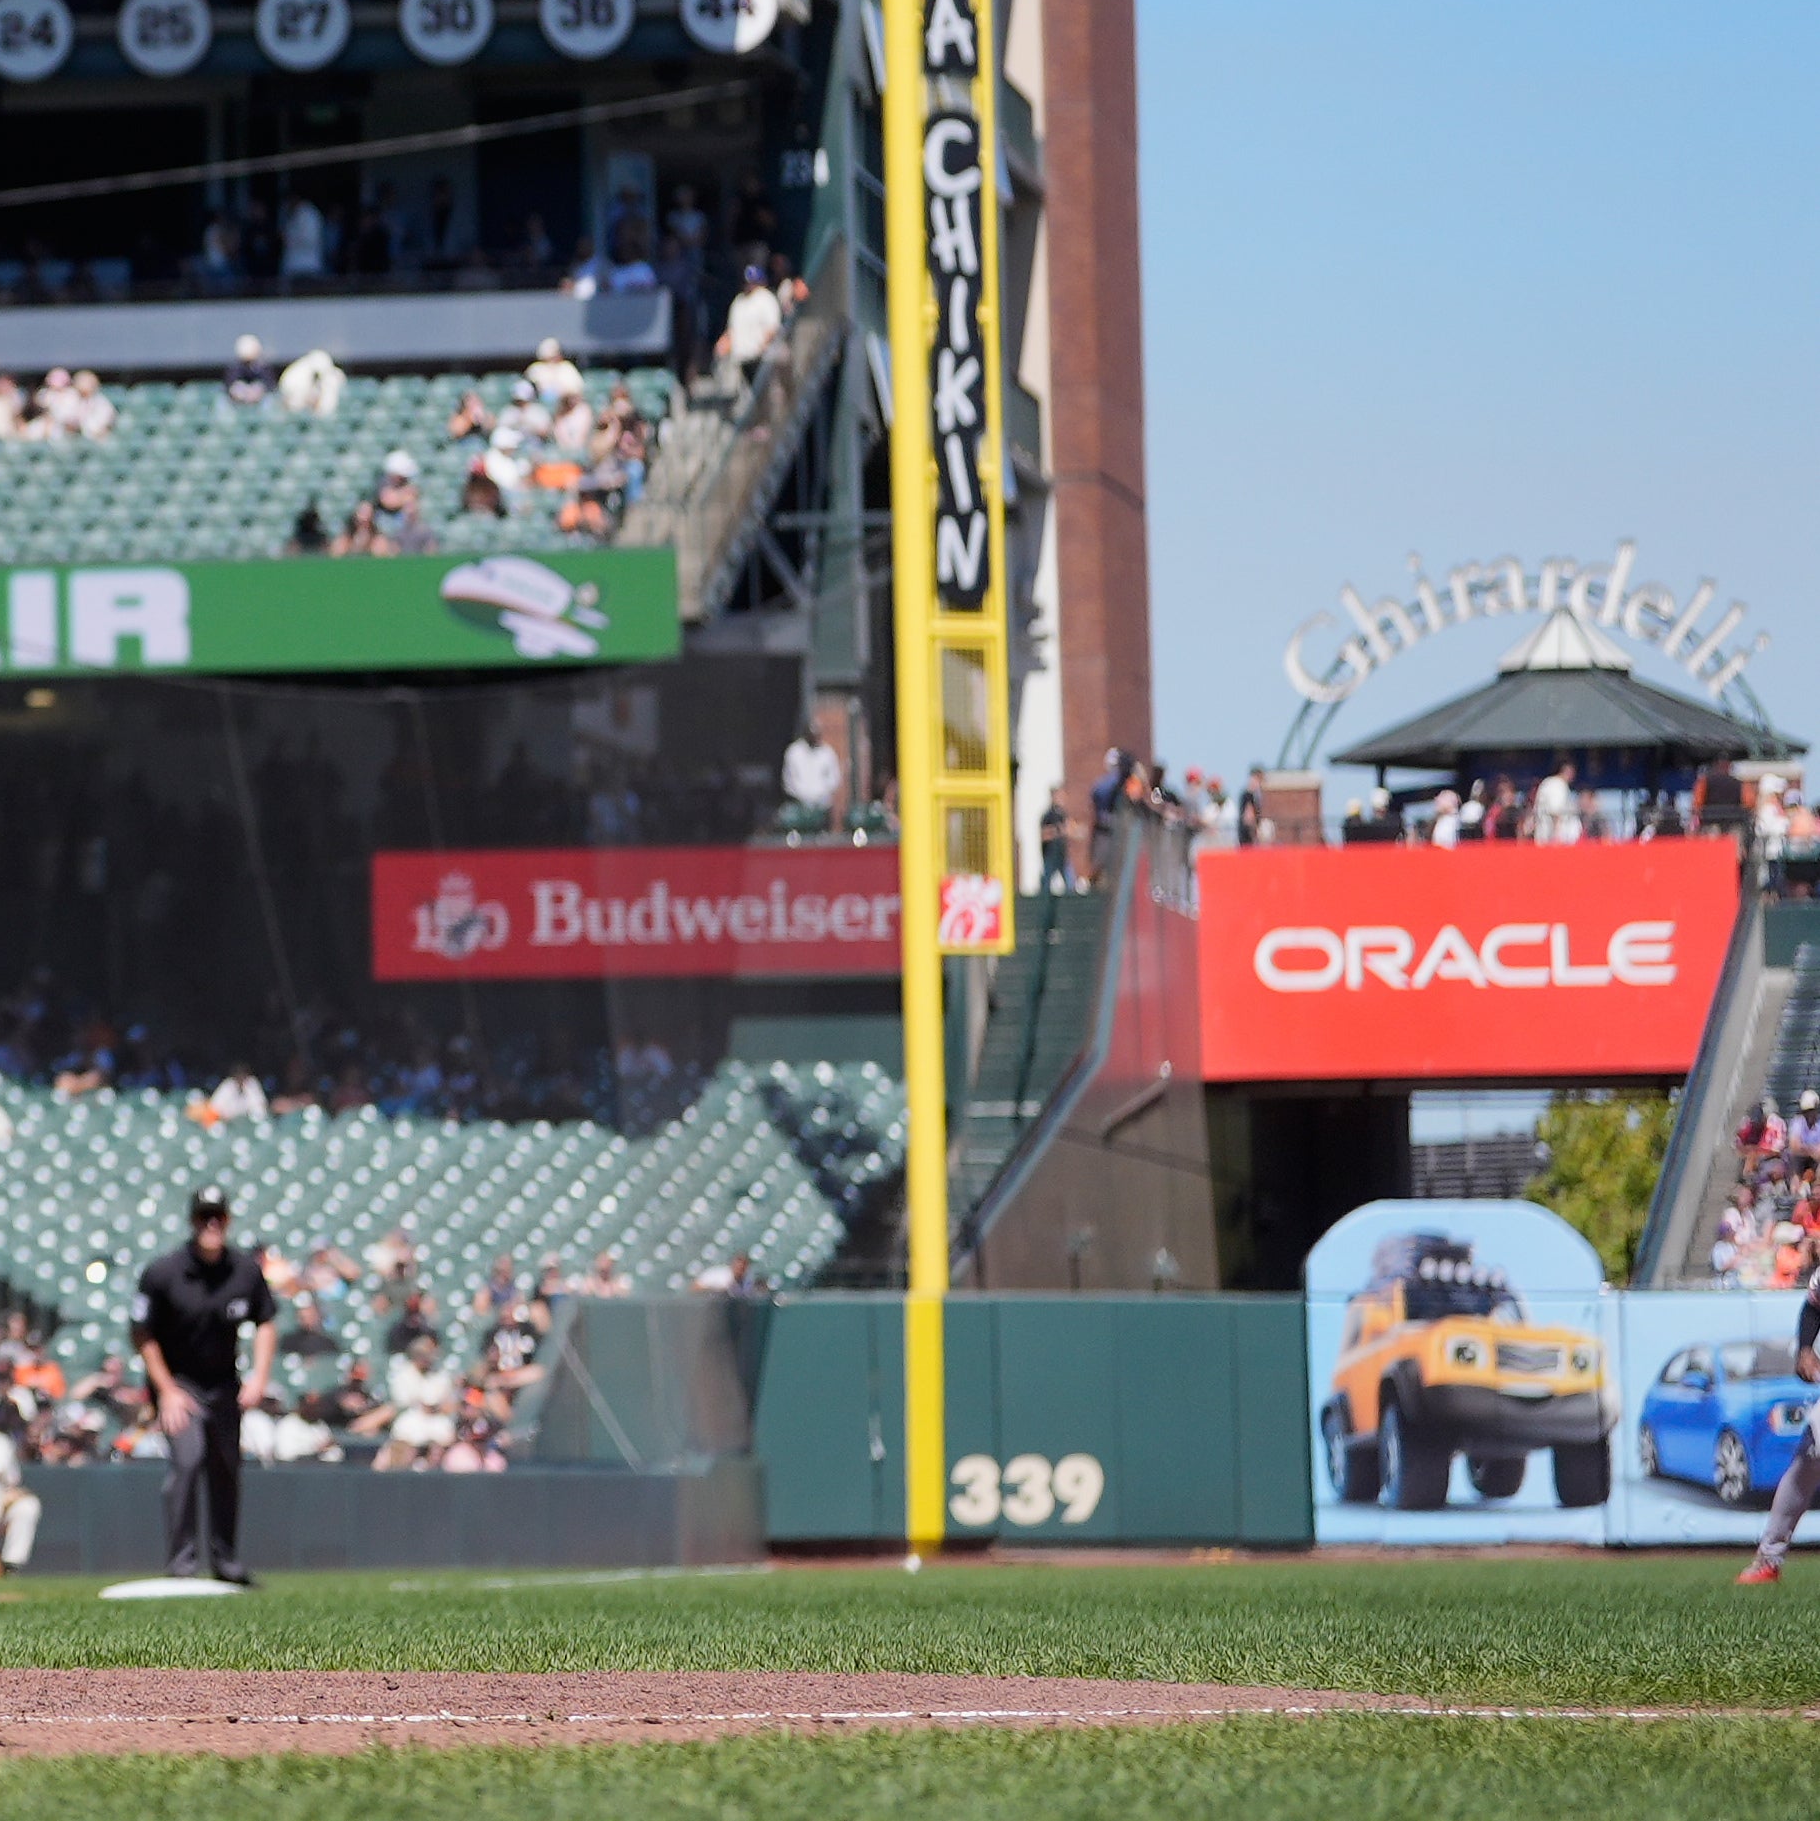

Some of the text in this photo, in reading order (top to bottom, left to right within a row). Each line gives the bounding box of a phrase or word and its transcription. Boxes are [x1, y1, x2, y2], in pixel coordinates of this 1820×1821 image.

[923, 117, 987, 591] CHIKIN
[1284, 538, 1769, 703] Ghirardelli
[529, 881, 901, 947] Budweiser
[1254, 920, 1677, 992] ORACLE
[950, 1453, 1106, 1526] 339
